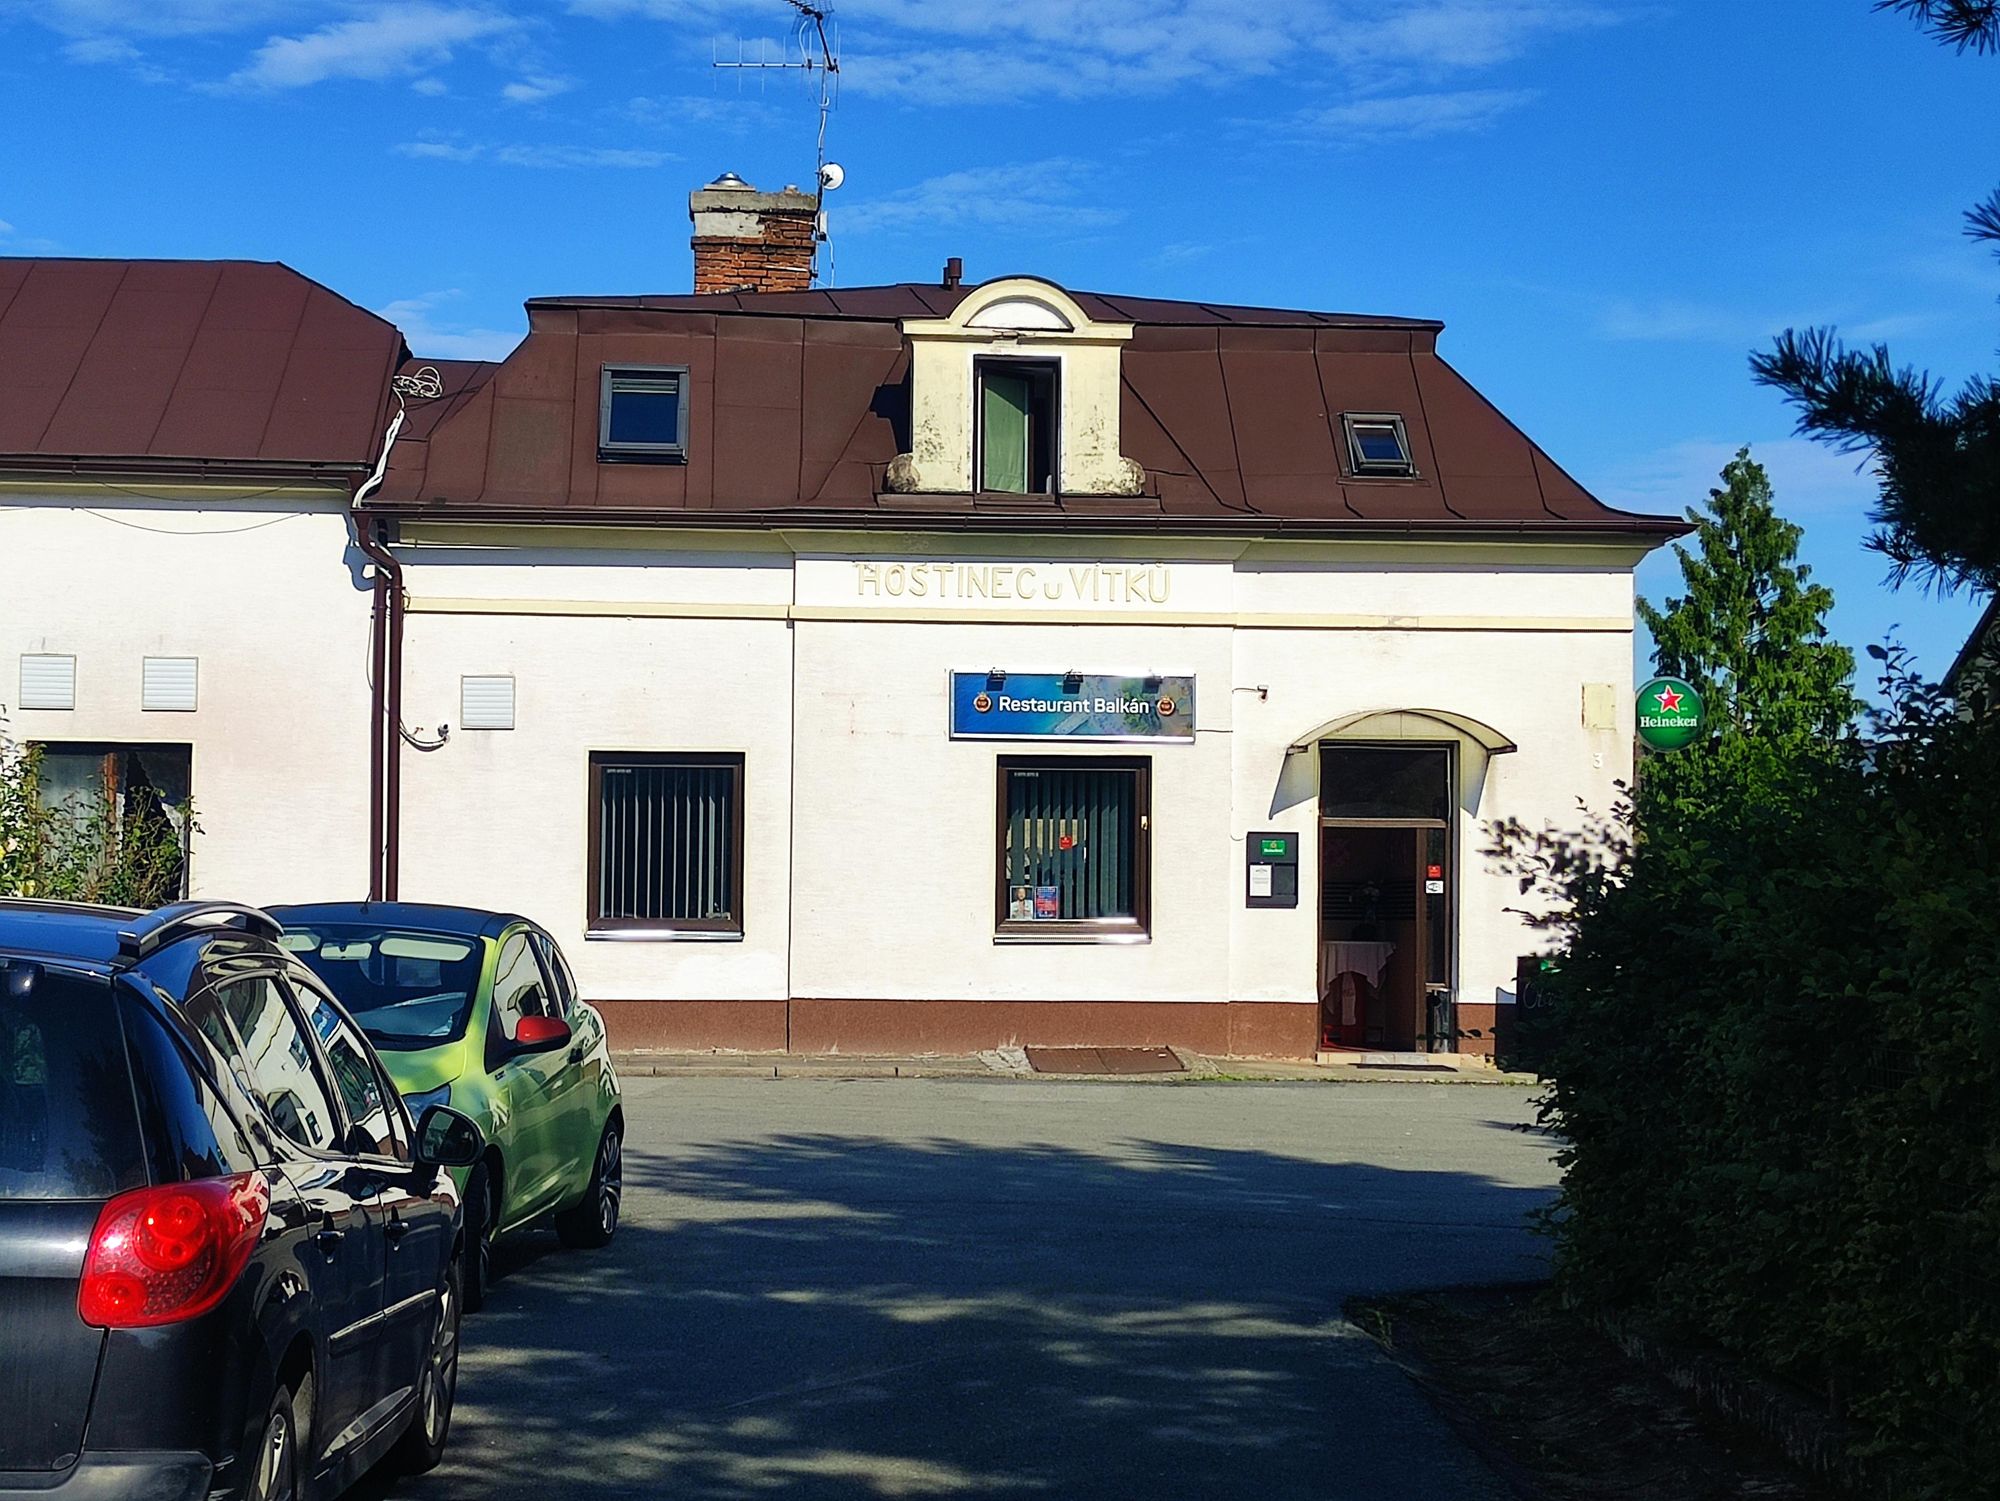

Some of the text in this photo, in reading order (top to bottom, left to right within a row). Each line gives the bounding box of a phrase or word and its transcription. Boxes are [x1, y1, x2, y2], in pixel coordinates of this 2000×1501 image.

[858, 562, 1036, 600] HOSTINEC
[998, 696, 1149, 714] Restaurant Balkán
[1640, 715, 1698, 728] Heineken
[1592, 752, 1604, 770] 3
